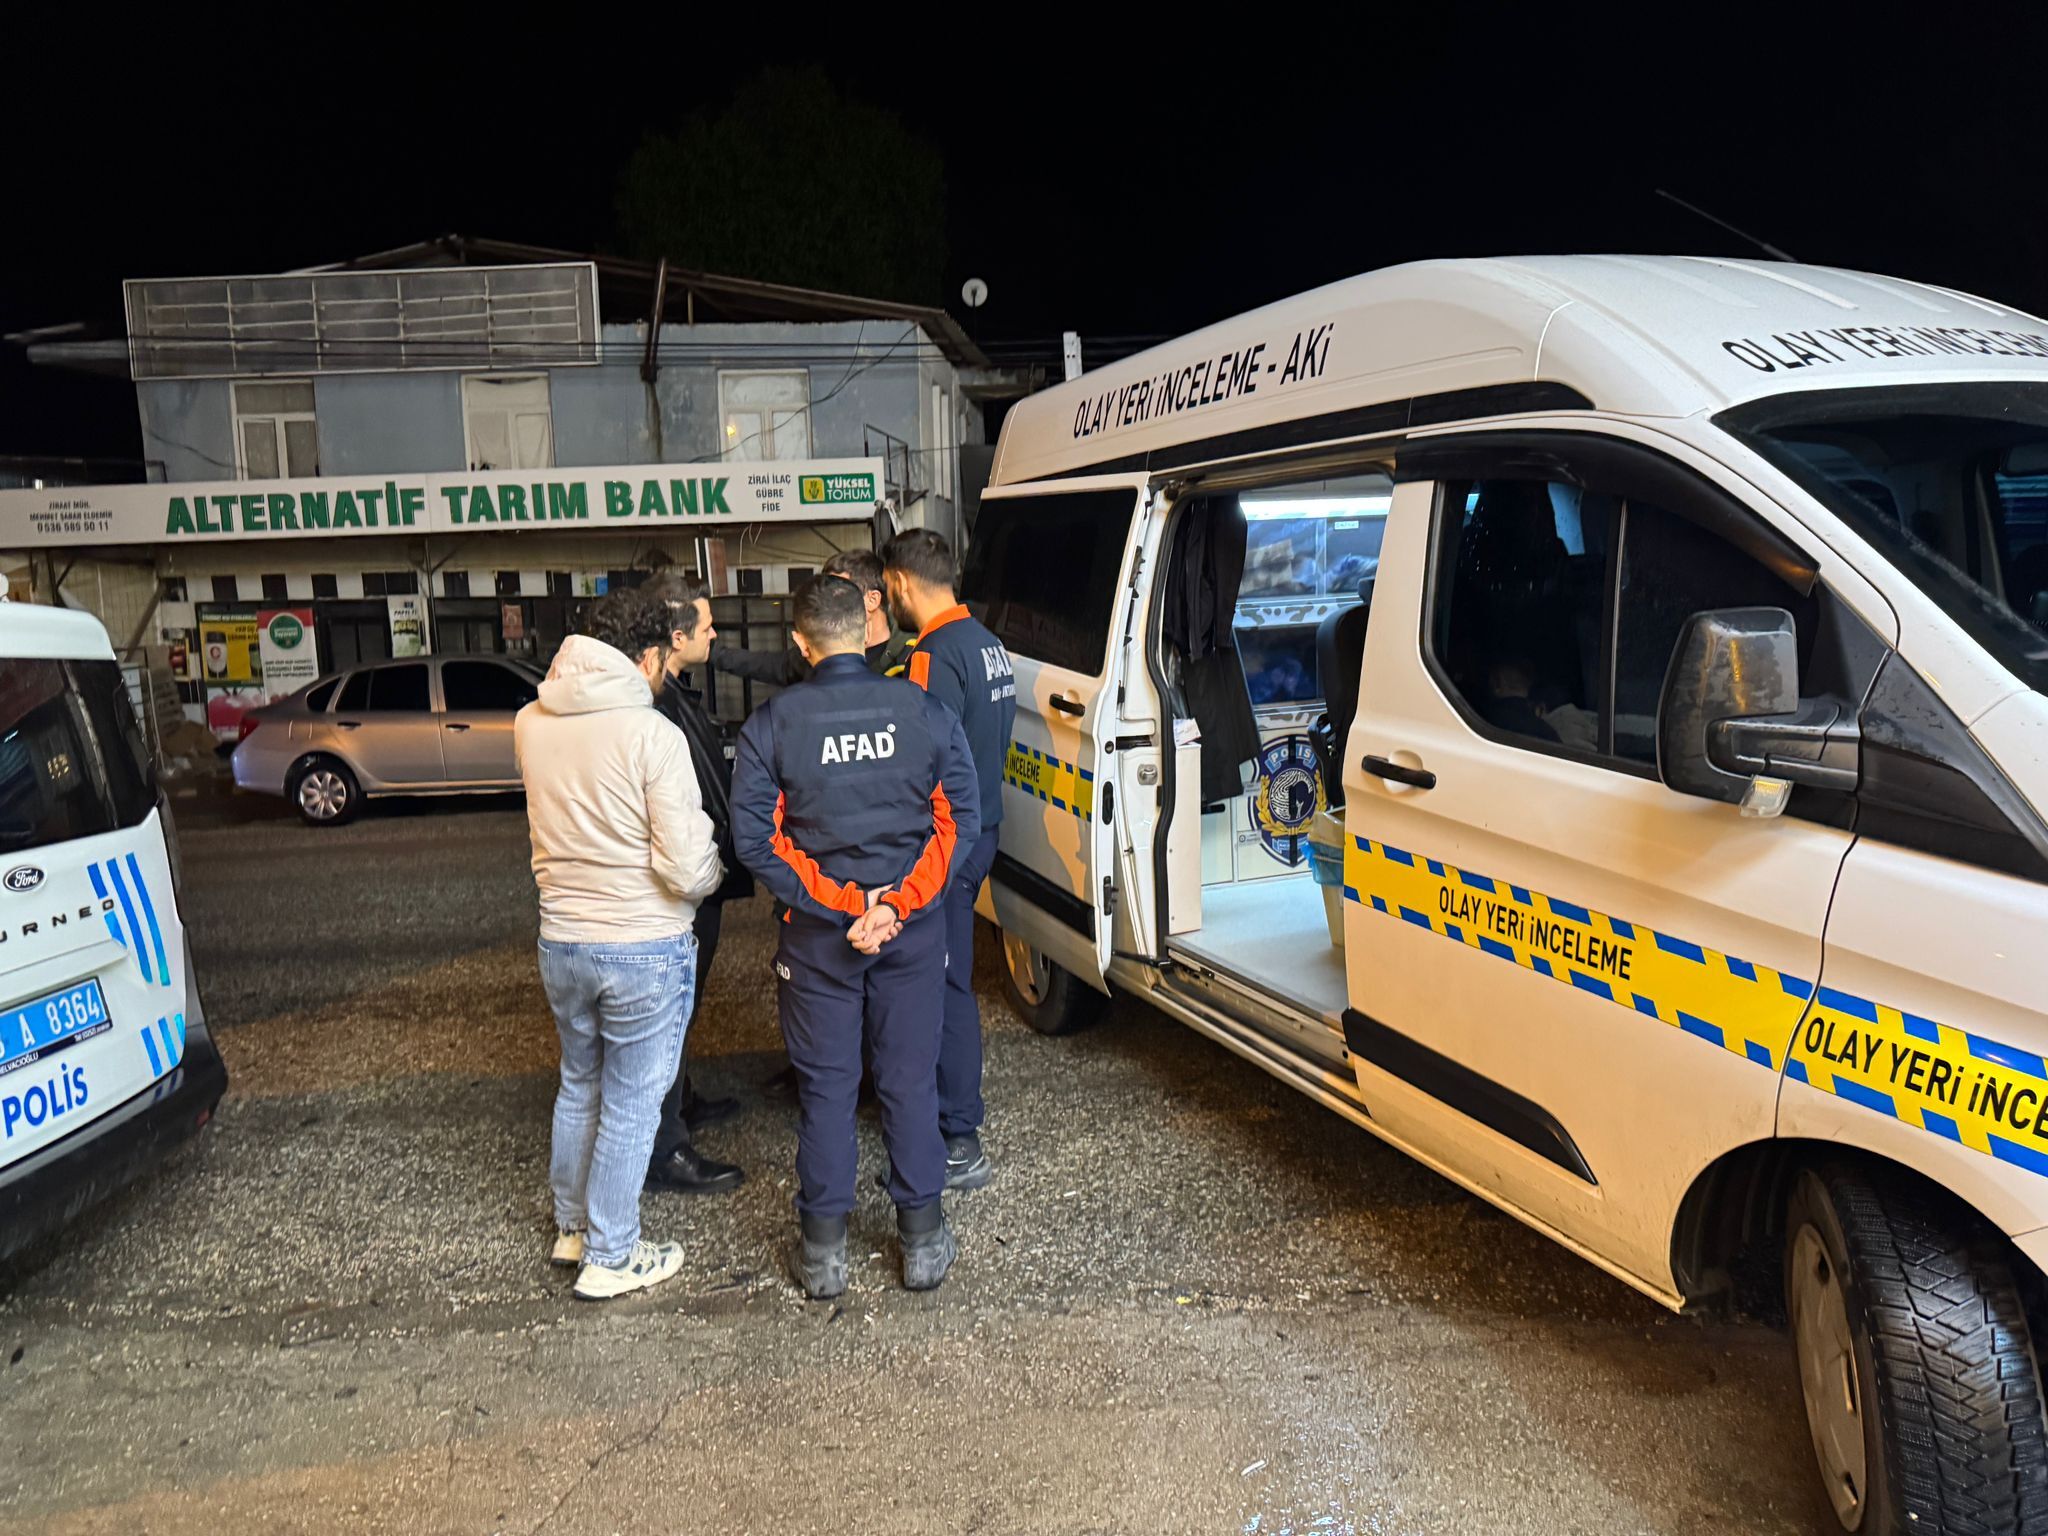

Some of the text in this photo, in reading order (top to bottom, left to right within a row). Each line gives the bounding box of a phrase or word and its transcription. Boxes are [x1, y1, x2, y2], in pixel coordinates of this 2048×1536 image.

[1721, 329, 1846, 373] OLAY
[1073, 389, 1117, 439] OLAY
[755, 488, 785, 498] GÜBRE
[772, 472, 791, 486] İLAÇ
[826, 476, 871, 489] YÜKSEL
[827, 488, 872, 500] TOHUM
[166, 477, 731, 534] ALTERNATİF TARIM BANK
[761, 502, 782, 512] FİDE
[821, 731, 895, 765] AFAD
[1438, 885, 1482, 925] OLAY
[18, 1013, 36, 1048] A
[46, 987, 100, 1035] 8364
[1805, 1017, 1884, 1074] OLAY
[2, 1062, 88, 1139] POLİS
